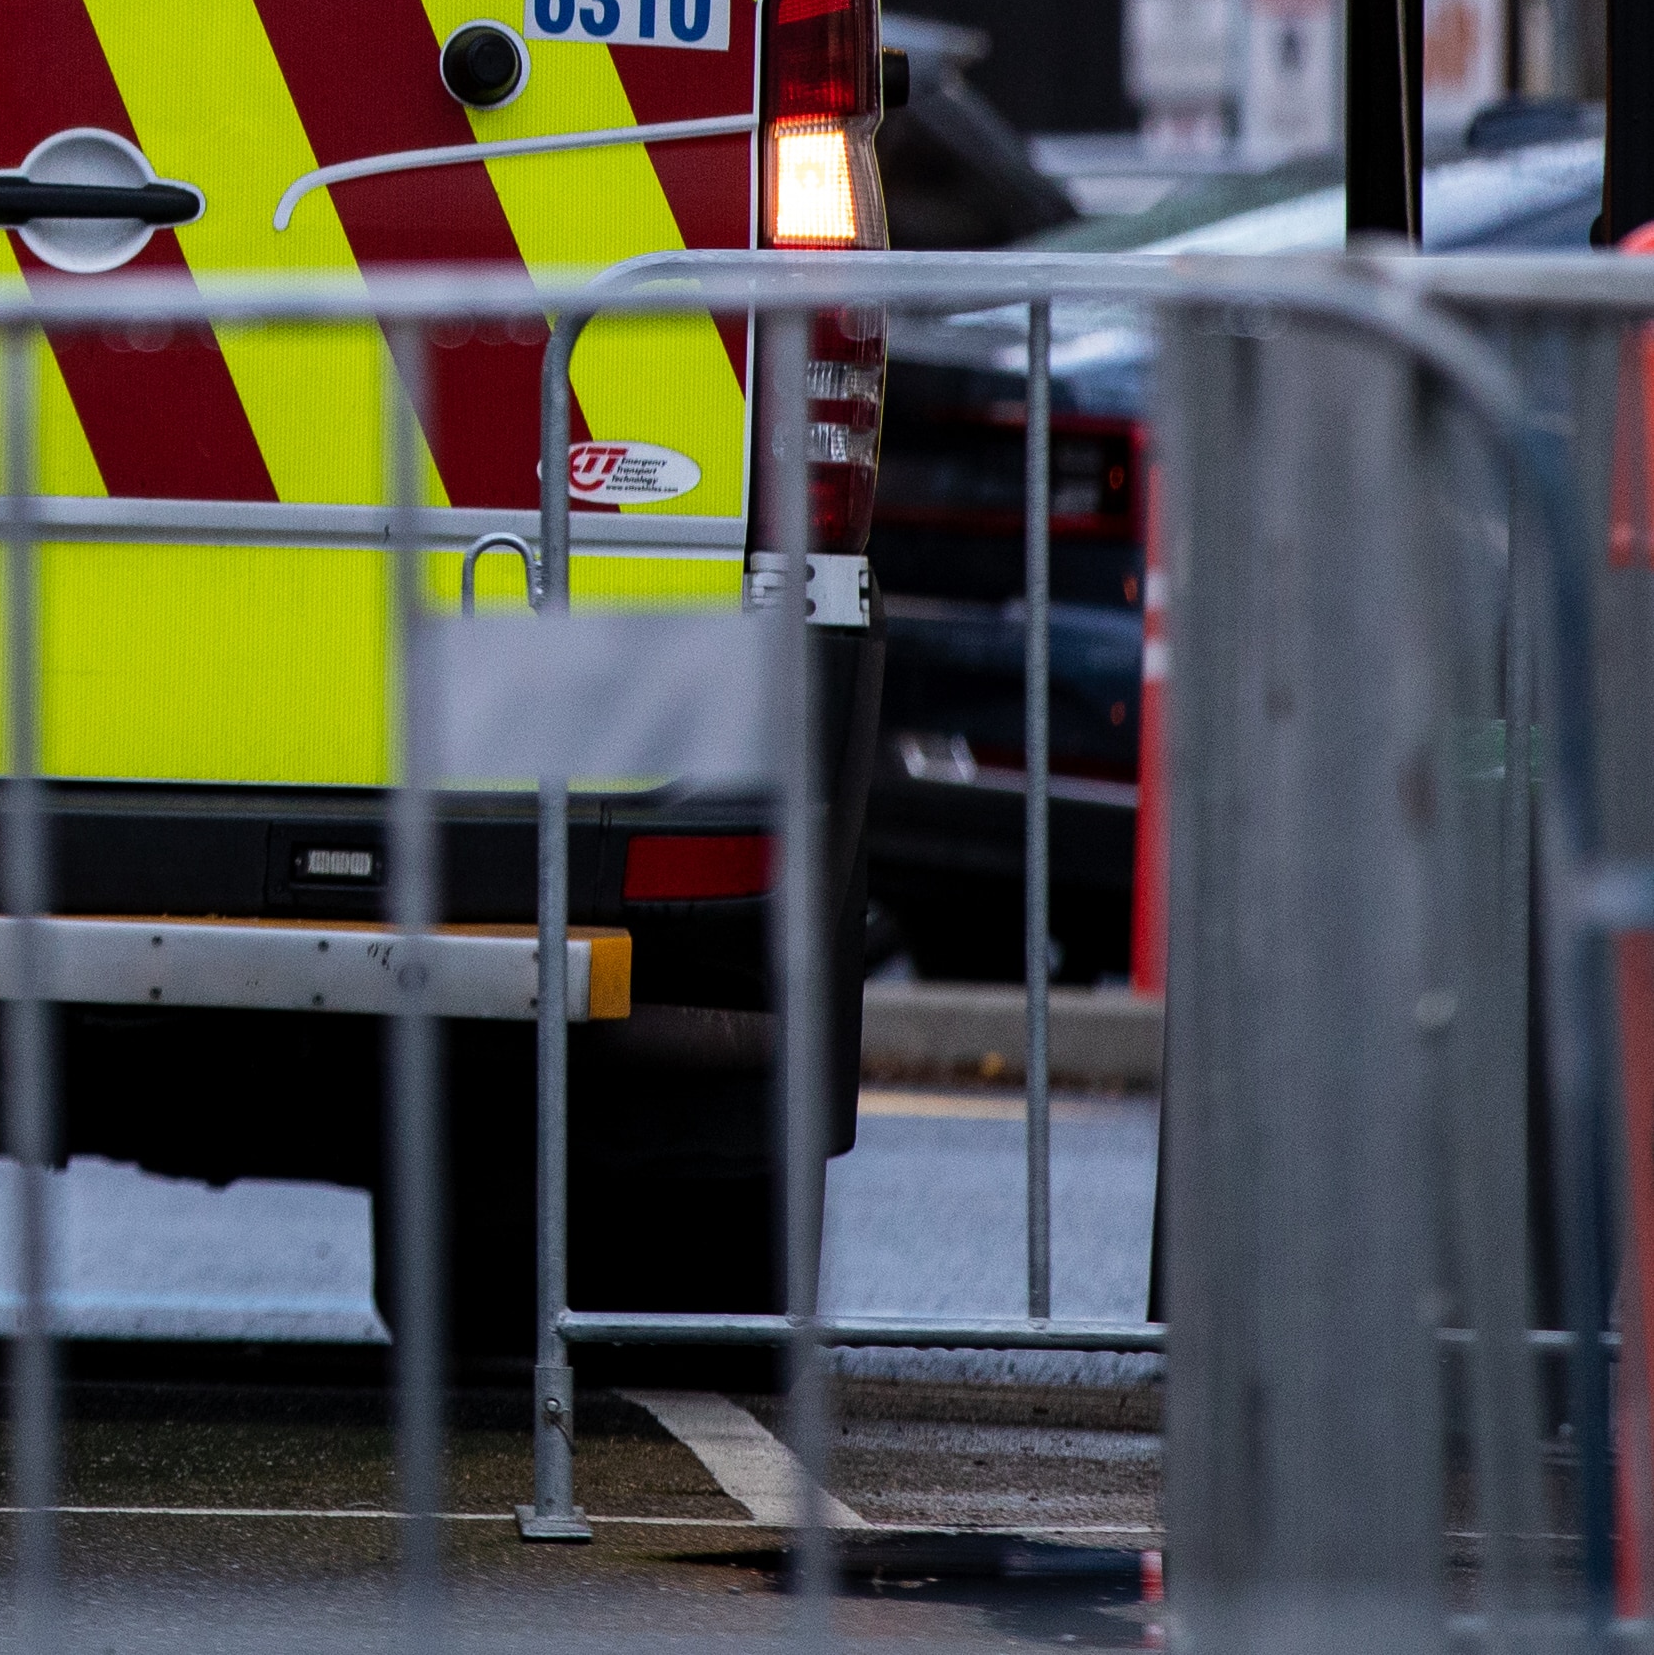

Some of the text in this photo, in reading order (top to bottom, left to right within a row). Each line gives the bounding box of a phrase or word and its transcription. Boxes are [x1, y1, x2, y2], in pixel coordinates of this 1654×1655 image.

[621, 457, 668, 468] Emergency
[616, 466, 658, 475] Transport
[611, 474, 659, 485] Technology
